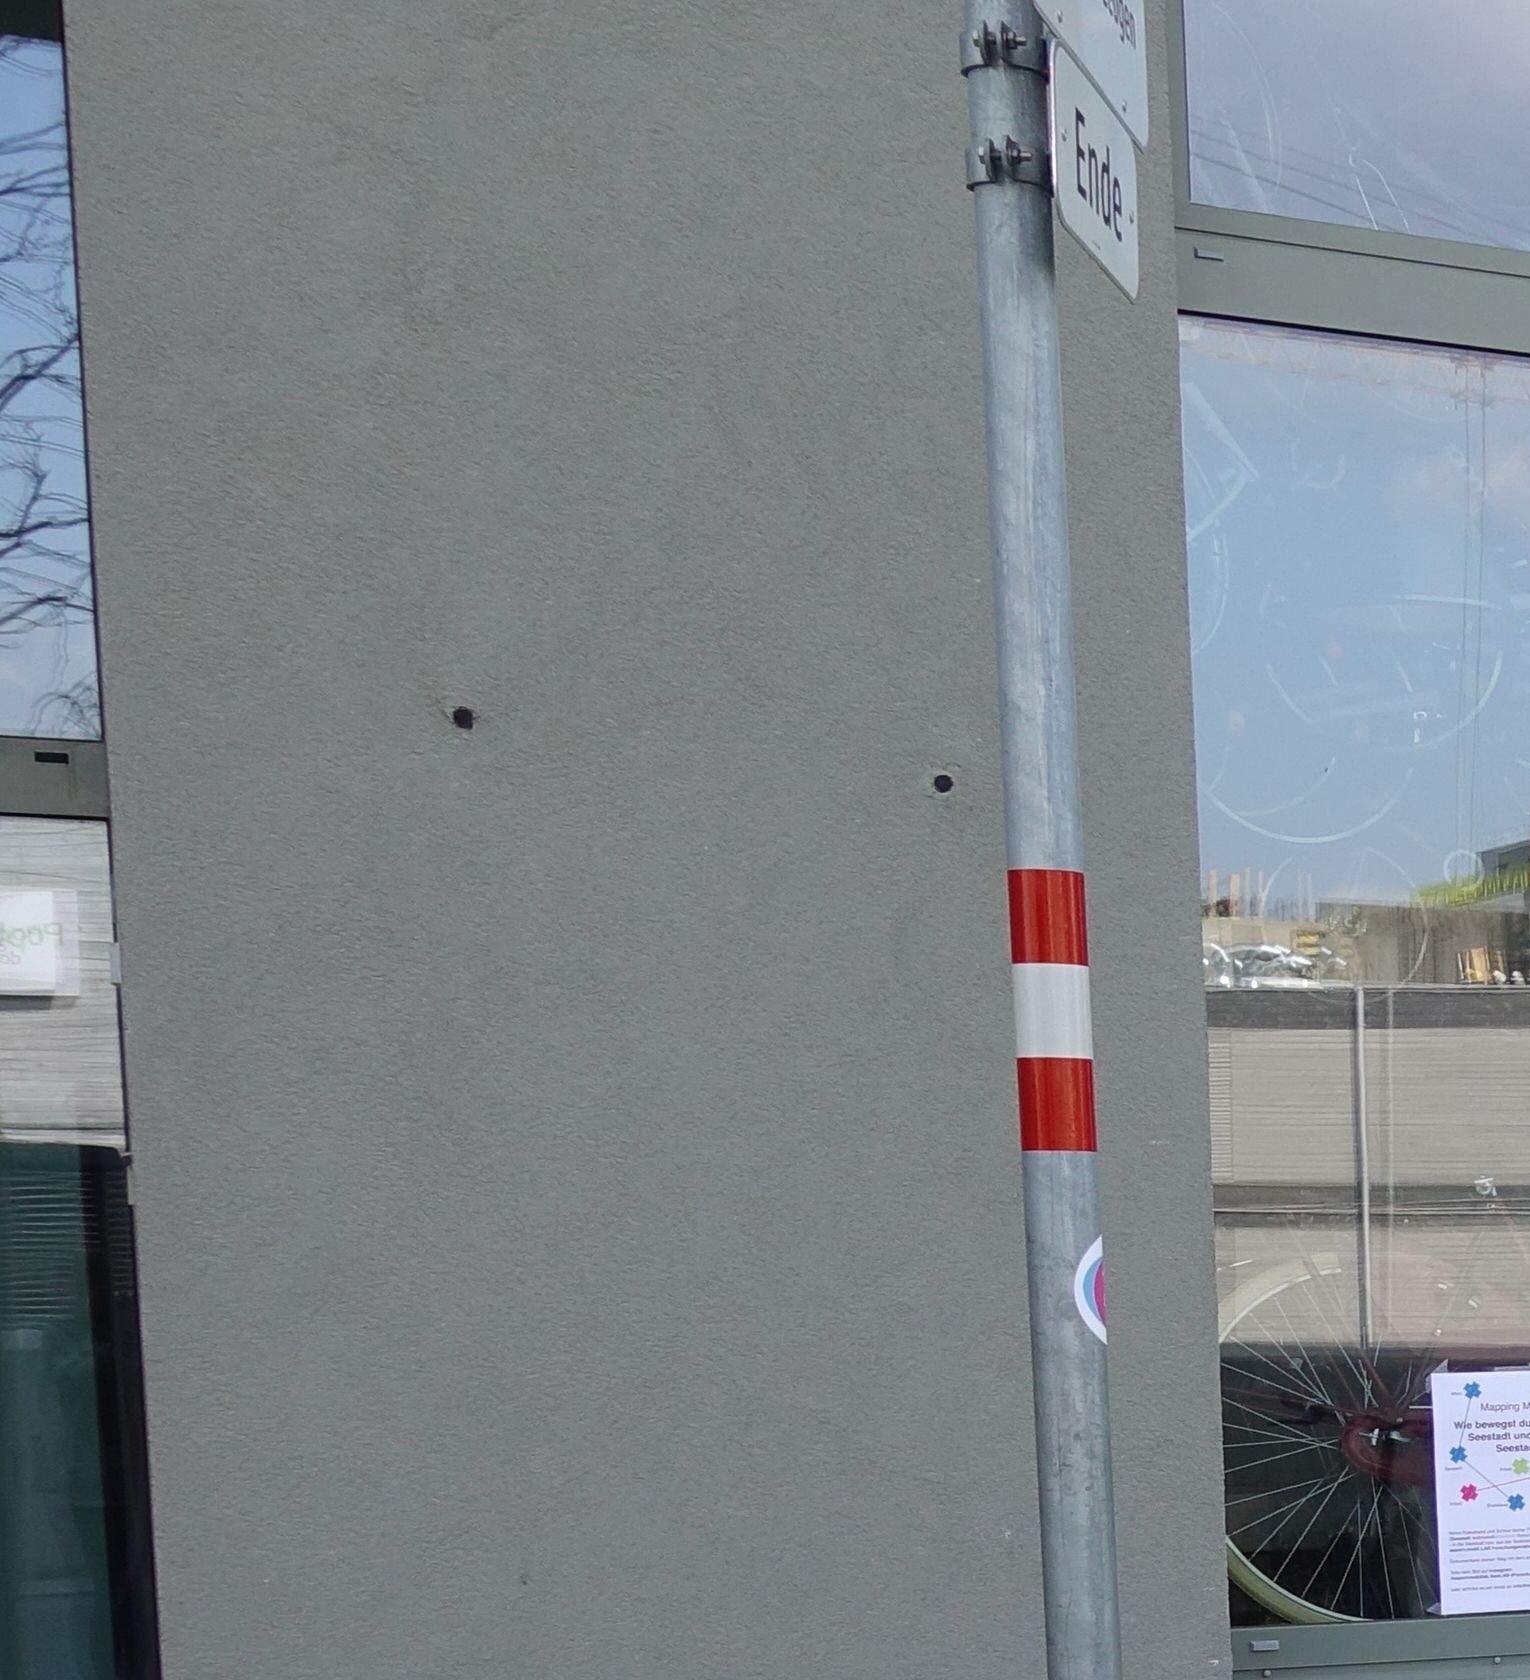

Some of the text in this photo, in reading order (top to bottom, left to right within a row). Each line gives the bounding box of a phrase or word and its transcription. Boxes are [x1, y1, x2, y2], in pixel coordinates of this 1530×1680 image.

[1075, 106, 1123, 243] Ende
[1480, 1403, 1520, 1412] Mapping
[1454, 1421, 1472, 1429] Wie
[1475, 1419, 1516, 1429] bewegst
[1519, 1419, 1530, 1428] du
[1468, 1432, 1510, 1441] Seestadt
